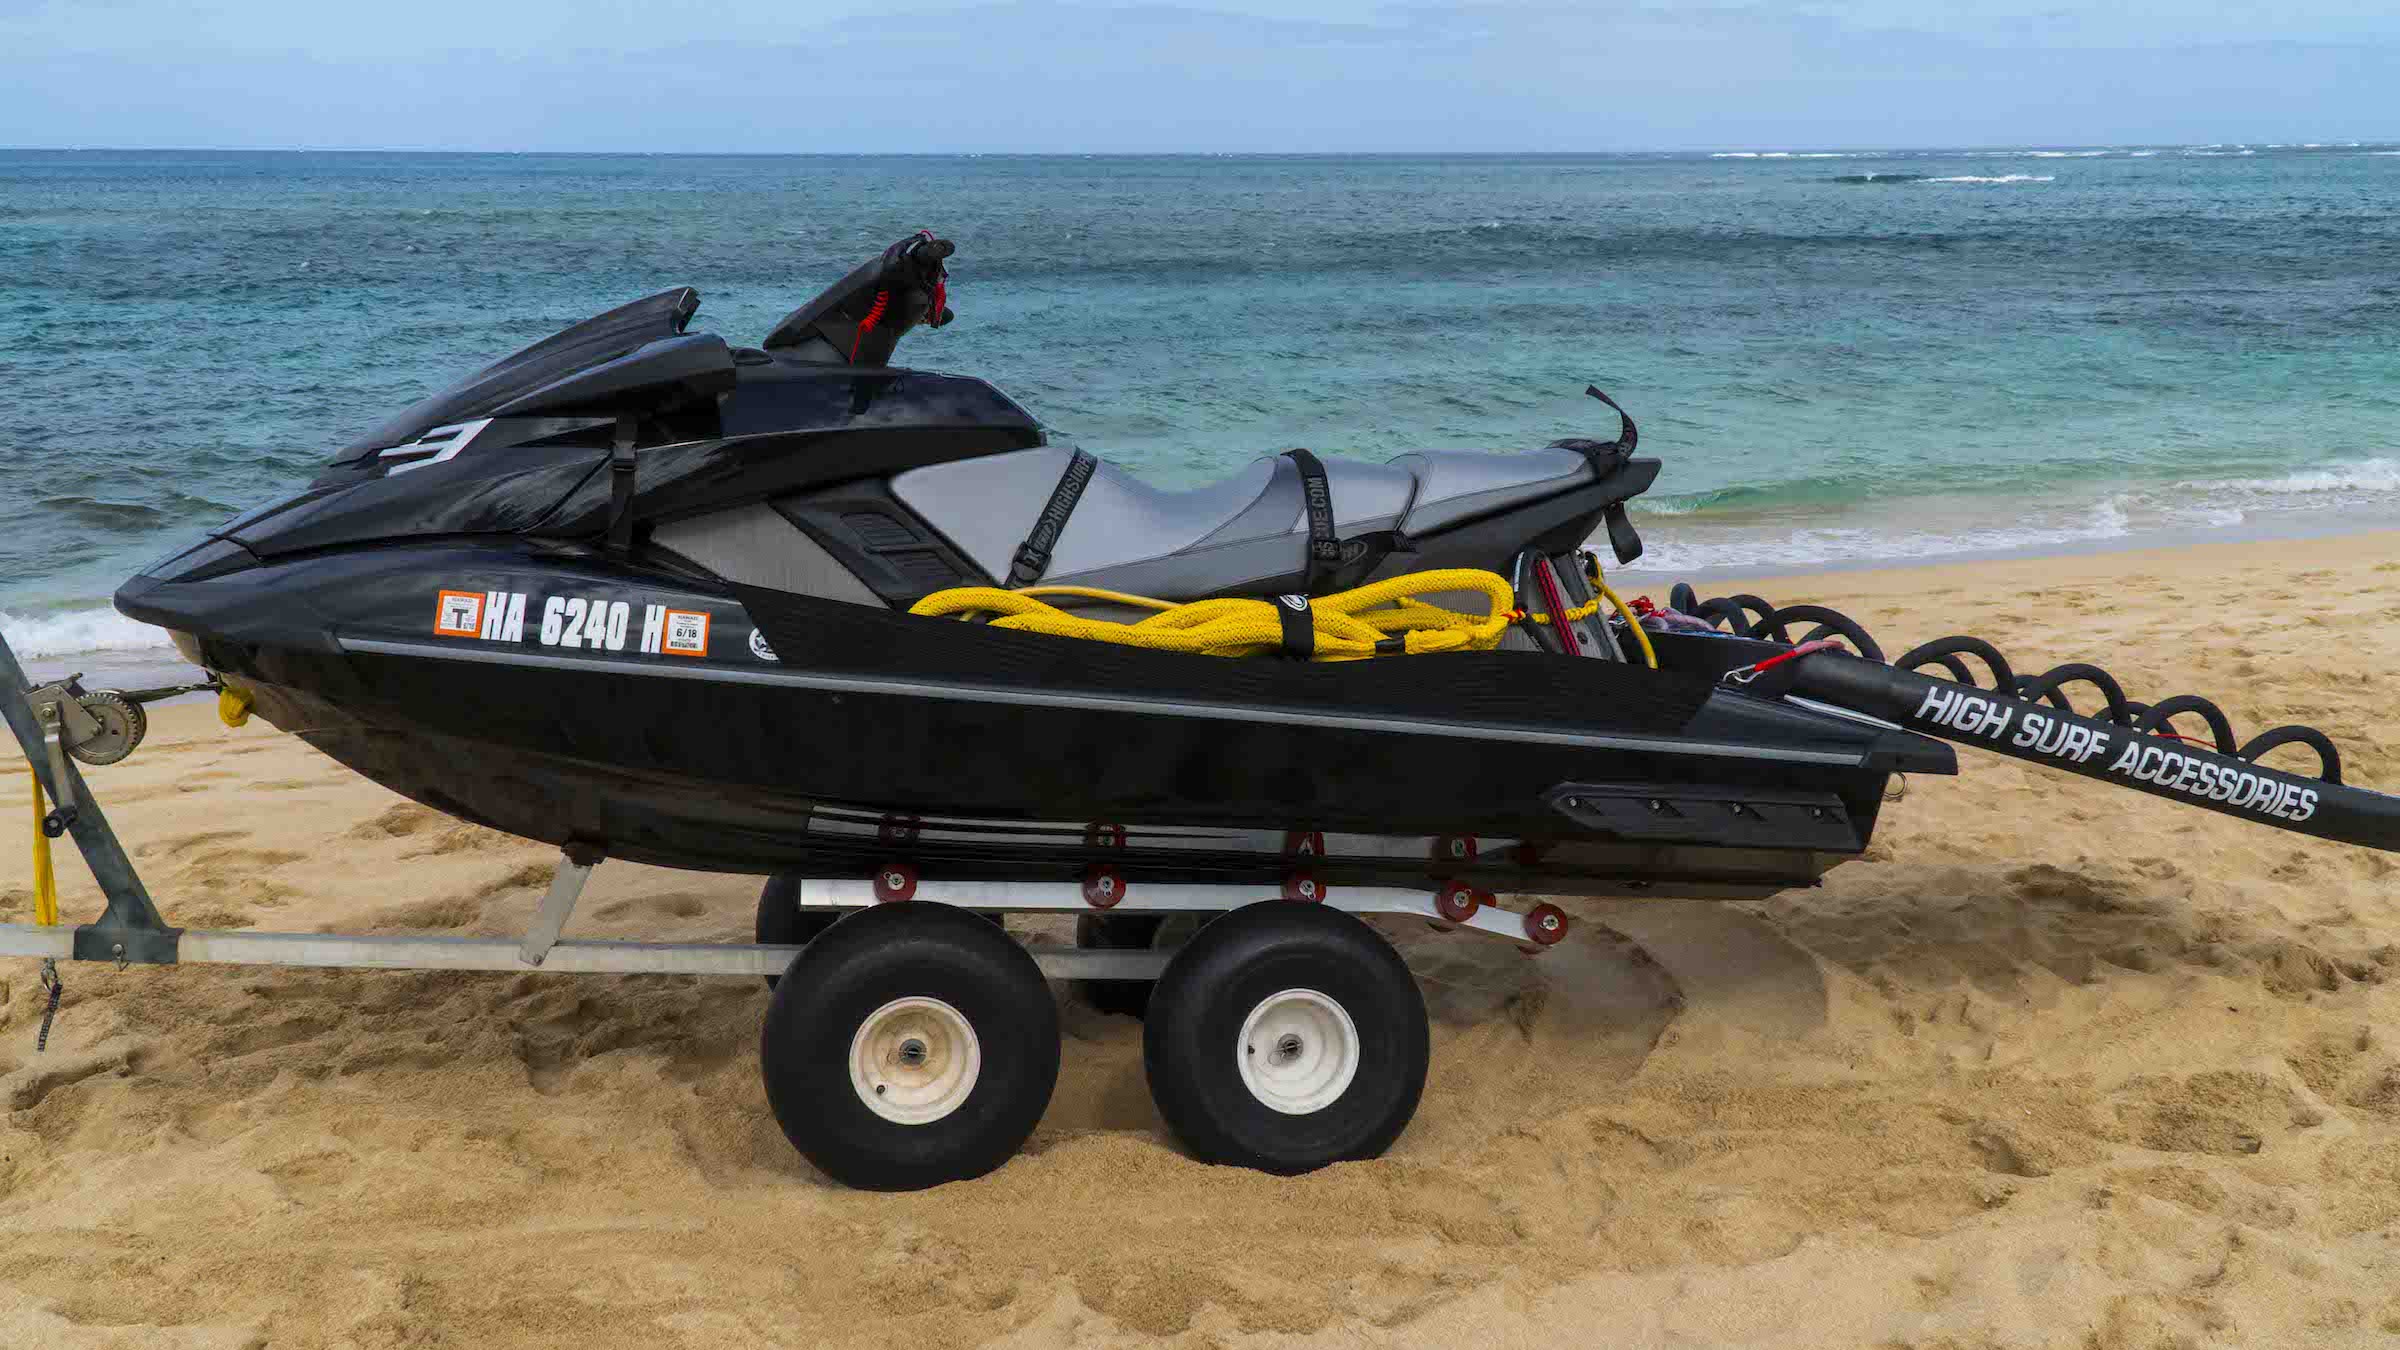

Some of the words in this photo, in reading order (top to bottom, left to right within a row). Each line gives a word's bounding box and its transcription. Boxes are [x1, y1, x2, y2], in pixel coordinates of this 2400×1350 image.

[452, 608, 469, 629] T
[480, 591, 527, 642] HA
[540, 596, 630, 651] 6240
[641, 604, 666, 654] H
[676, 628, 697, 638] 6/18
[1915, 686, 2013, 738] HIGH
[2013, 712, 2110, 763] SURF
[2109, 742, 2319, 822] ACCESSORIES
